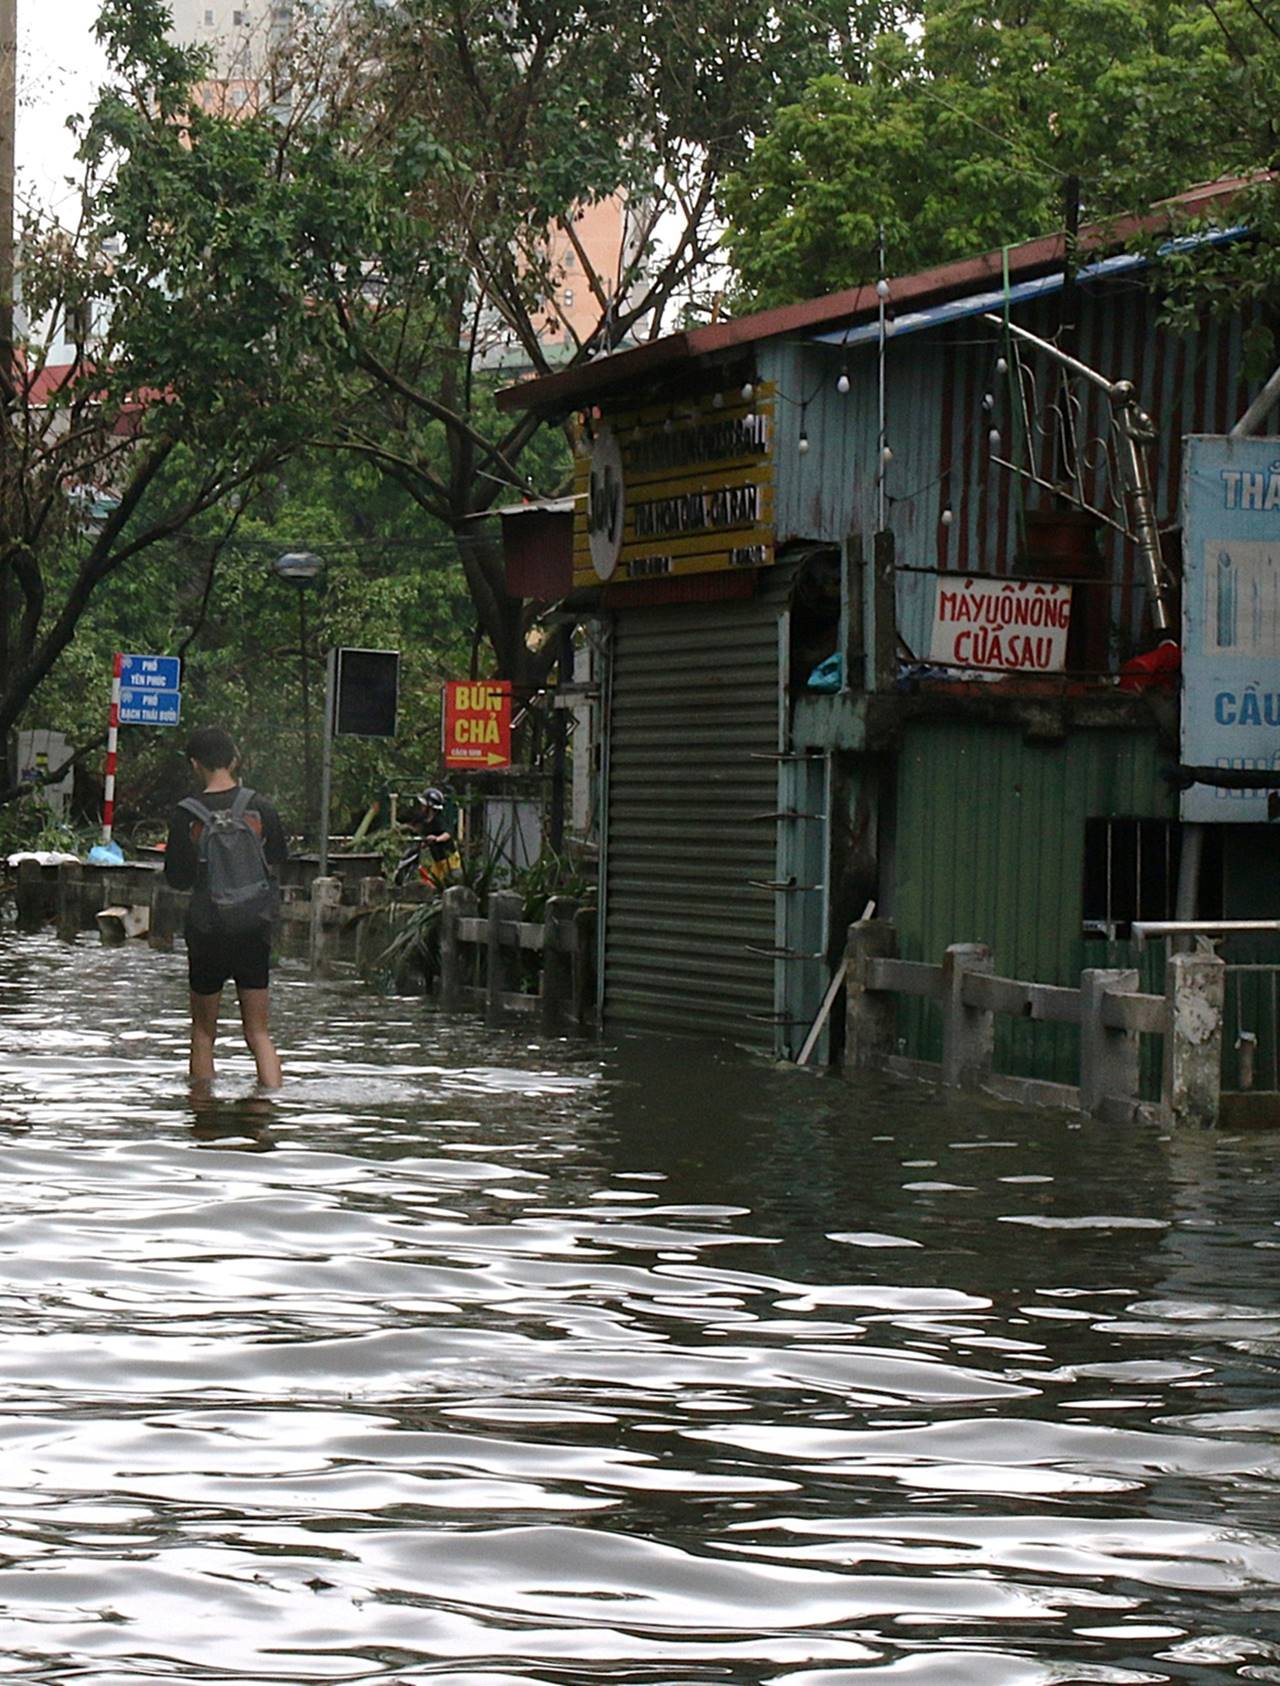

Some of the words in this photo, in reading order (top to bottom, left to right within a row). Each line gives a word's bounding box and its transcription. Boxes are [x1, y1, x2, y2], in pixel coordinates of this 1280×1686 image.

[142, 659, 158, 671] PHỐ
[131, 673, 145, 685] YÊN
[146, 674, 166, 686] PHÚC
[142, 692, 158, 706] PHỐ
[455, 682, 502, 711] BÚN
[455, 712, 500, 743] CHẢ
